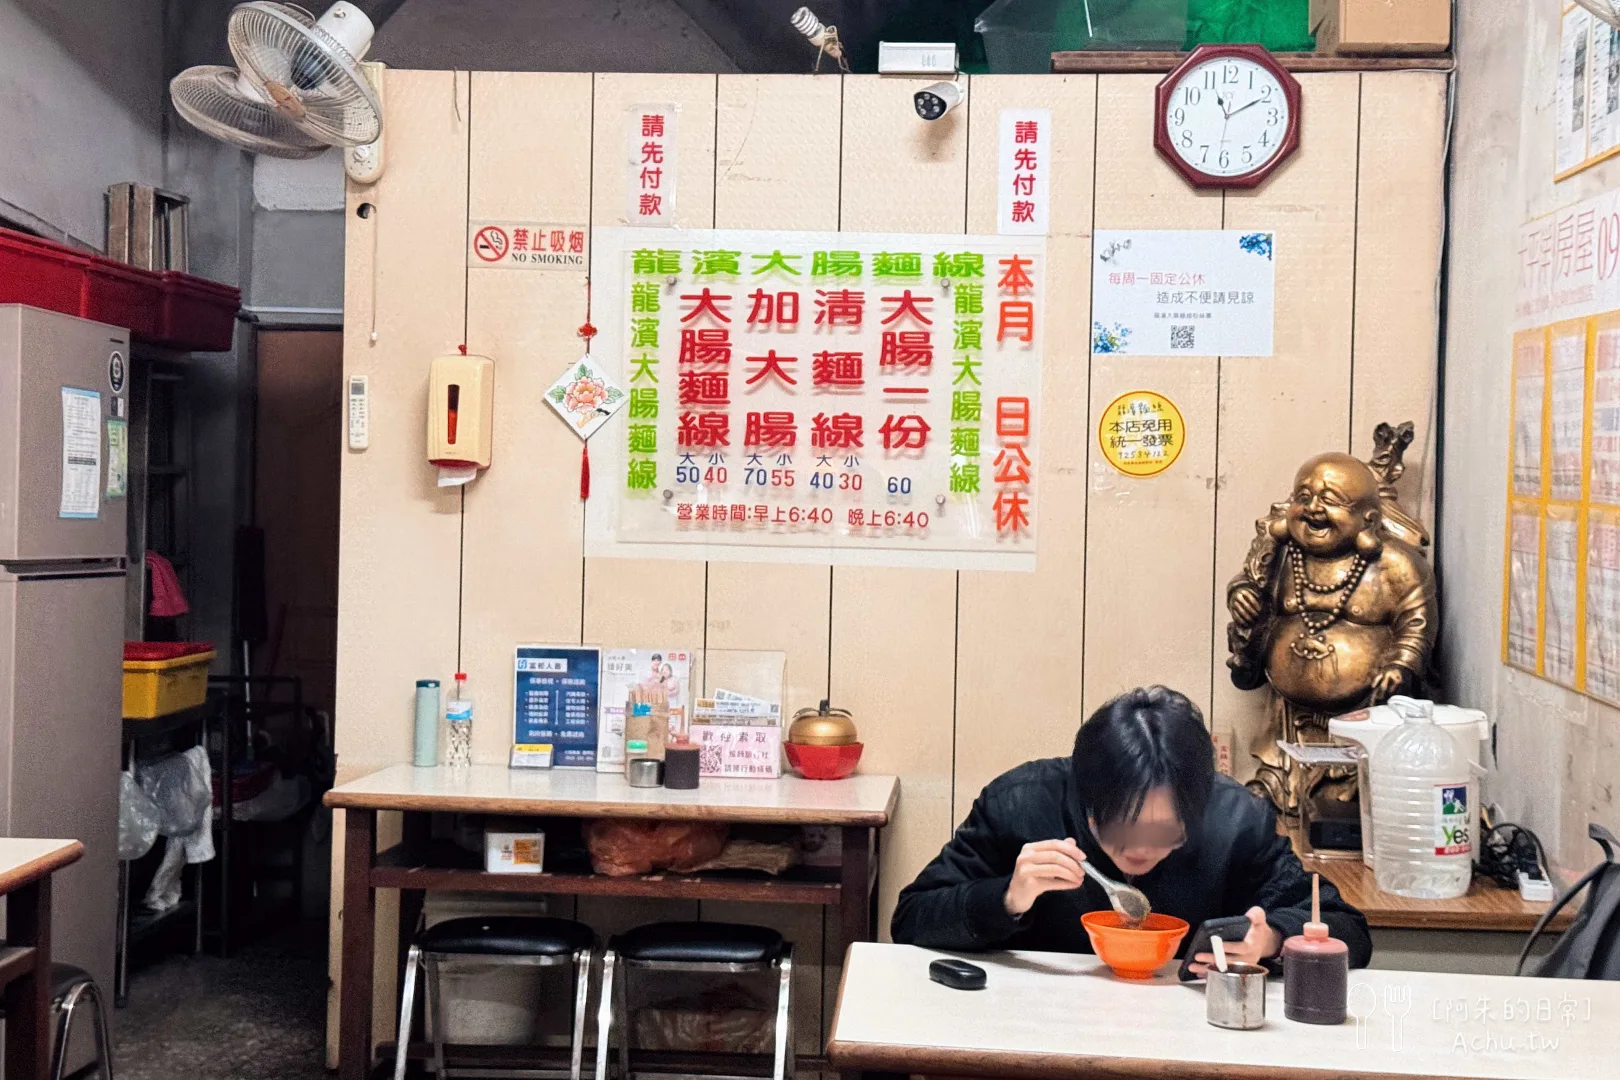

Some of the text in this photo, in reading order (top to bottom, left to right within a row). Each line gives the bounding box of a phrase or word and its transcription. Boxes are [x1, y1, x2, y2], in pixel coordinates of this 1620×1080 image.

[1204, 70, 1216, 89] 11
[1222, 65, 1239, 84] 12
[1248, 70, 1254, 89] 1
[1184, 86, 1200, 105] 10
[1261, 85, 1272, 103] 2
[1174, 108, 1185, 126] 9
[1266, 108, 1278, 126] 3
[1181, 130, 1193, 148] 8
[1257, 130, 1269, 147] 4
[1200, 145, 1210, 163] 7
[1218, 149, 1229, 168] 6
[1241, 145, 1252, 163] 5
[639, 114, 664, 216] 請先付款
[1012, 121, 1038, 222] 請先付款
[511, 253, 583, 265] NO SMOKING
[631, 248, 985, 277] 龍濱大腸麵線
[1108, 272, 1206, 286] 每周一固定公休
[1157, 291, 1254, 304] 造成不便請見諒
[678, 287, 732, 447] 大腸麵線
[744, 288, 799, 447] 加大腸
[811, 289, 866, 448] 清麵線
[878, 289, 934, 449] 大腸一份
[627, 282, 661, 489] 龍濱大腸麵線
[949, 283, 985, 493] 龍濱大腸麵線
[993, 254, 1034, 531] 本月 日公休
[1109, 419, 1172, 433] 本店免用
[1110, 434, 1173, 448] 統一發票
[680, 452, 724, 465] 大 小
[747, 453, 792, 466] 大 小
[816, 454, 860, 467] 大 小
[676, 466, 727, 483] 50 40
[744, 468, 795, 487] 70 55
[810, 472, 863, 490] 40 30
[888, 477, 911, 494] 60
[848, 509, 929, 528] 晚上6:40
